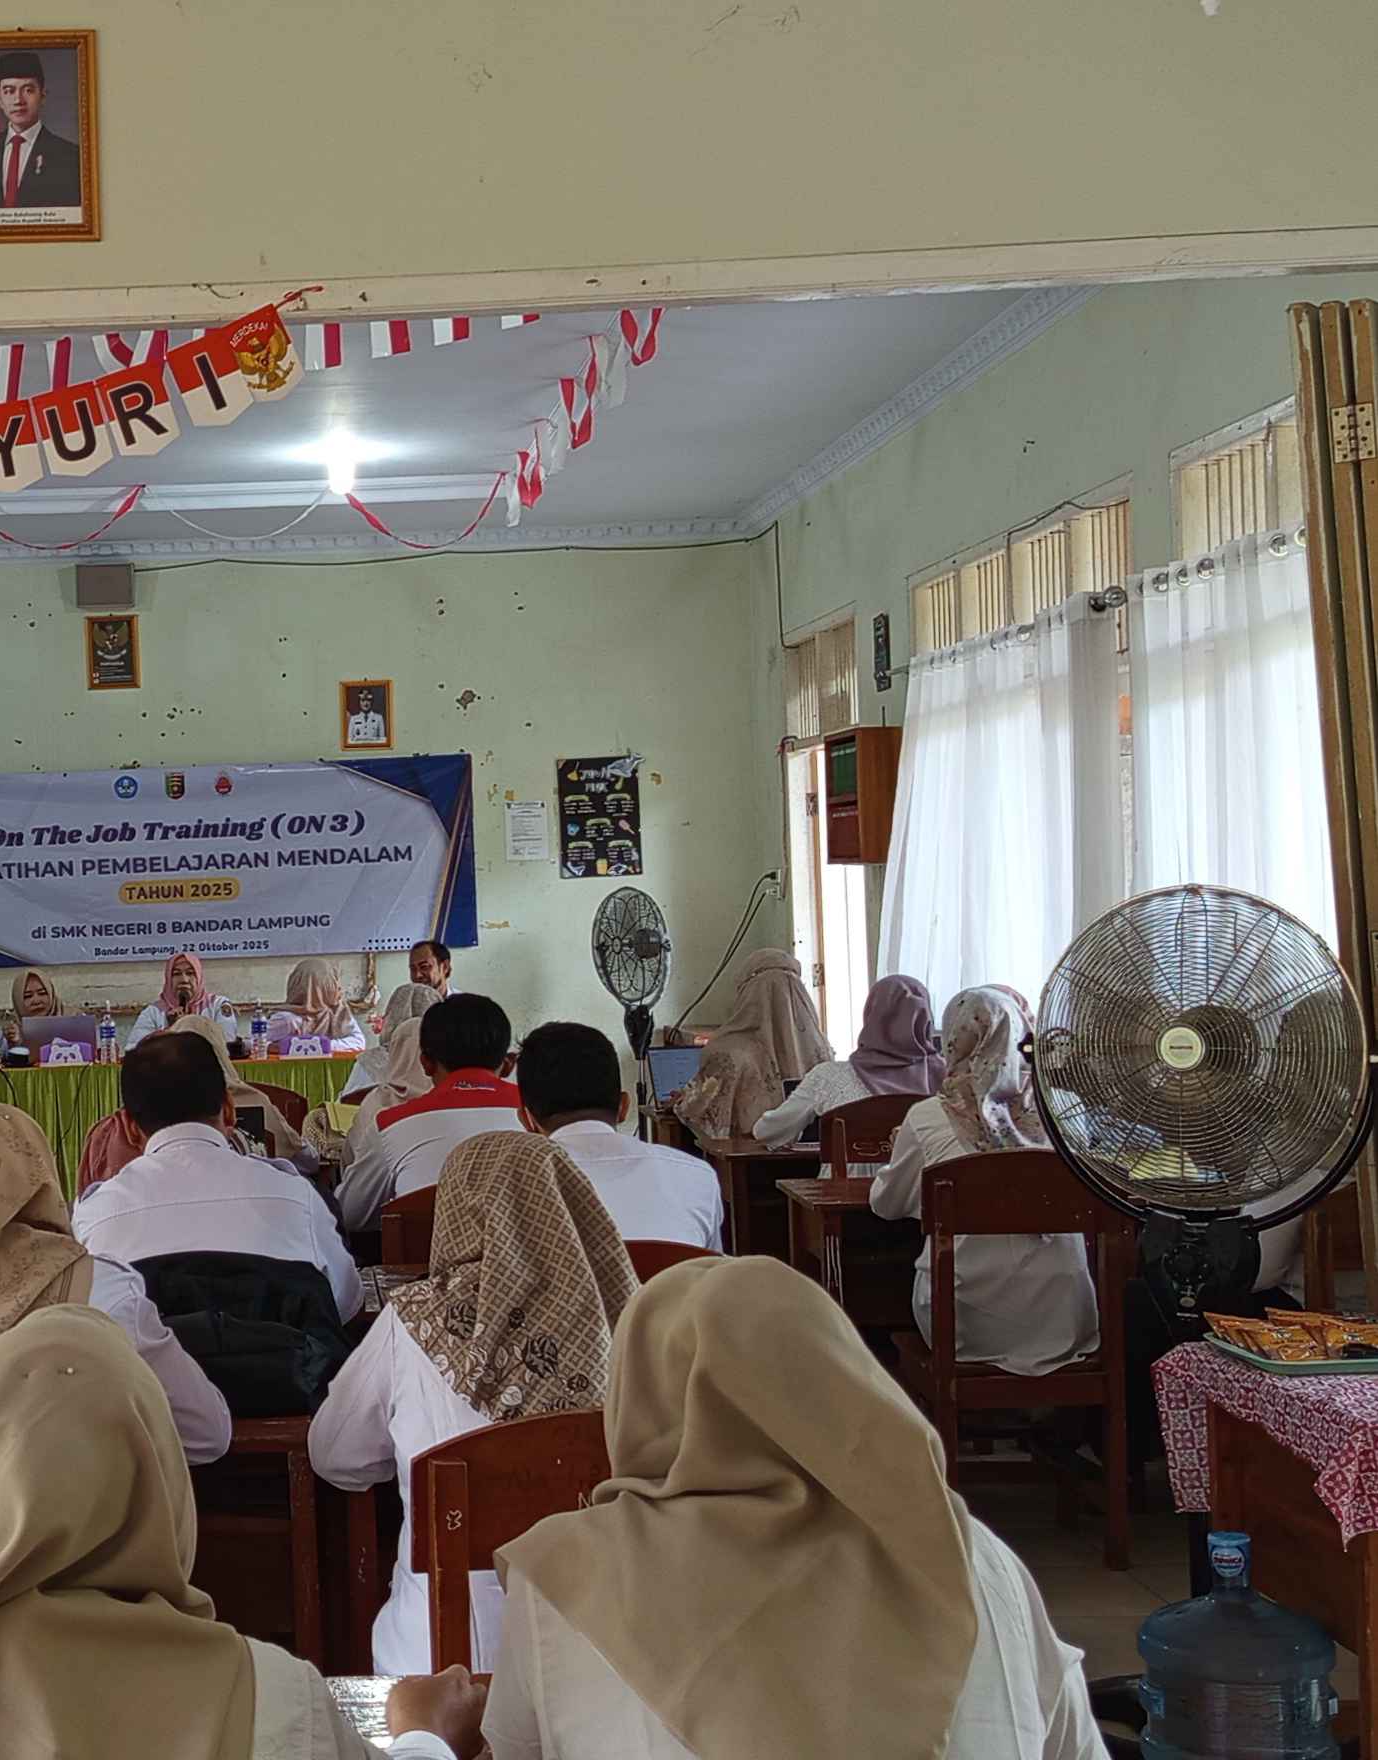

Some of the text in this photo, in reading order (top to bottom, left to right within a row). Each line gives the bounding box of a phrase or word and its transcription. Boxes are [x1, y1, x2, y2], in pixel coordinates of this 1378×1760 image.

[31, 825, 83, 846] The
[85, 822, 137, 844] Job
[143, 816, 267, 841] Training
[82, 851, 269, 876] PEMBELAJARAN
[277, 845, 413, 867] MENDALAM
[125, 881, 233, 900] TAHUN 2025
[31, 914, 331, 939] di SMK NEGERI 8 BANDAR LAMPUNG
[94, 946, 129, 957] Bandar
[182, 943, 195, 953] 22
[198, 941, 239, 952] Oktober
[242, 939, 270, 950] 2025
